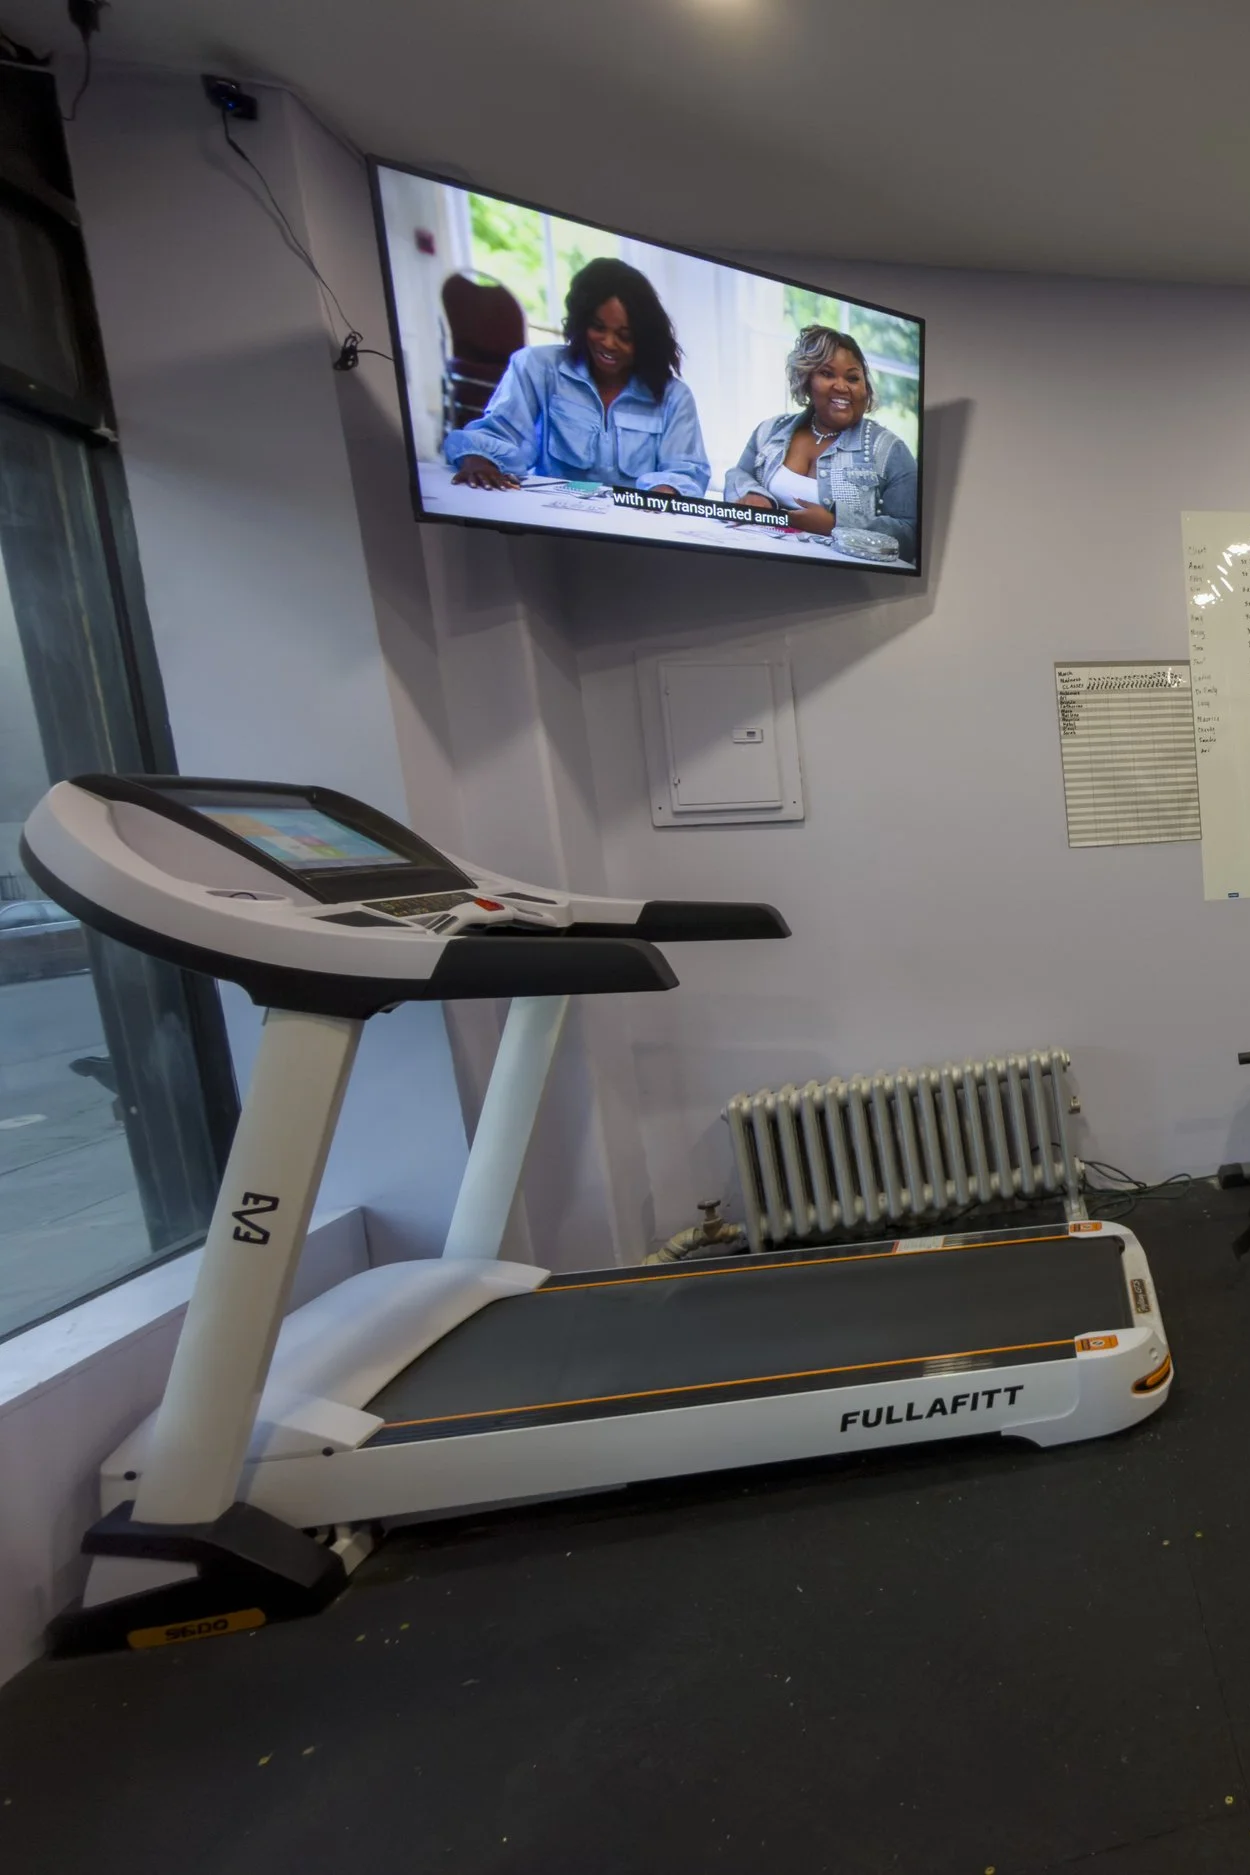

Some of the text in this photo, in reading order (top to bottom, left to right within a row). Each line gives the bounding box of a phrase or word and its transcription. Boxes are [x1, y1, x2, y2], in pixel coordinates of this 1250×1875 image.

[613, 492, 789, 526] with my transplanted arms!
[839, 1384, 1025, 1433] FULLAFITT
